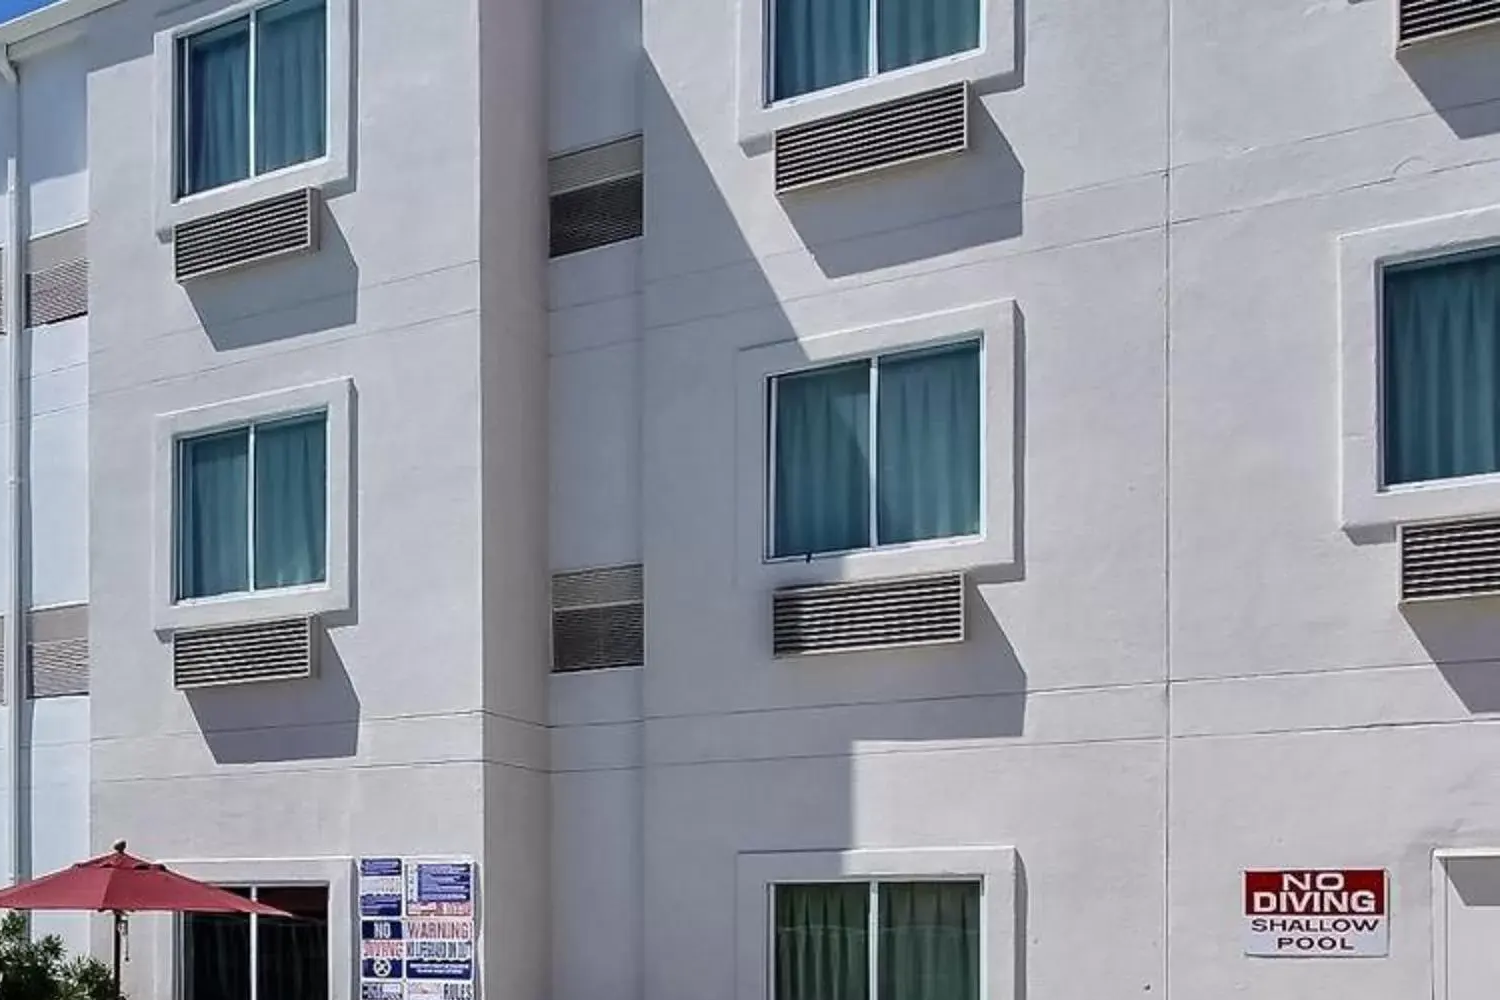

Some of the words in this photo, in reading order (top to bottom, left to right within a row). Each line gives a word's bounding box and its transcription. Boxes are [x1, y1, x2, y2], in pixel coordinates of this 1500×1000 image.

[1282, 873, 1345, 891] NO
[1253, 890, 1376, 913] DIVING
[373, 921, 391, 939] NO
[1251, 918, 1380, 933] SHALLOW
[1277, 936, 1355, 951] POOL
